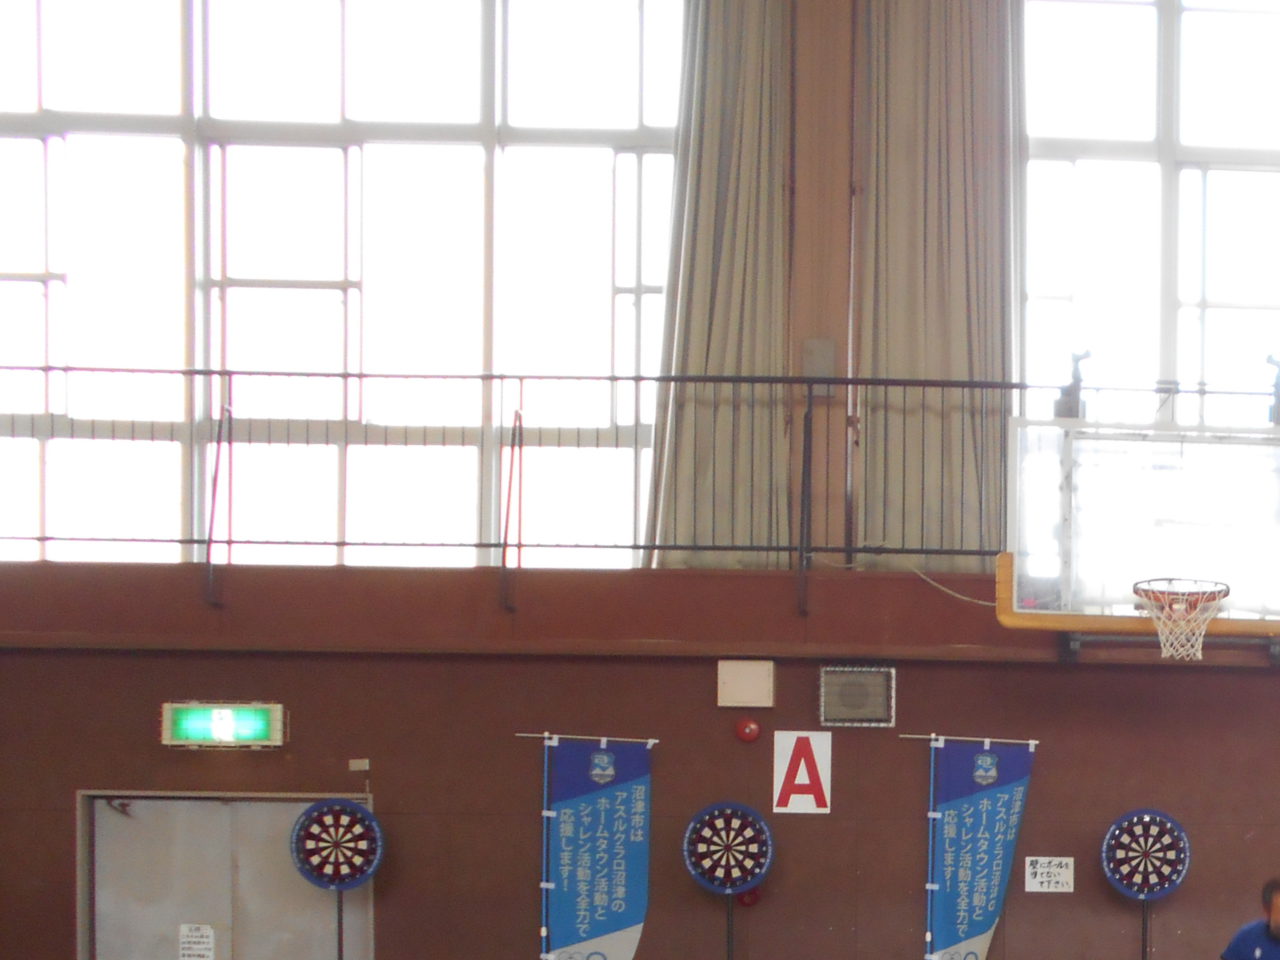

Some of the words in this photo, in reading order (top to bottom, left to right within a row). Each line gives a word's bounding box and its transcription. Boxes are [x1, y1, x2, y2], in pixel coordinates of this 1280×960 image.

[630, 785, 645, 842] 沼津市は
[776, 736, 828, 808] A
[559, 808, 574, 892] 応援します!
[594, 797, 610, 920] ホームタウン活動と
[611, 792, 627, 913] アスルクラロ沼津の
[943, 809, 958, 892] 応援します!
[972, 798, 992, 920] ホームタウン活動と
